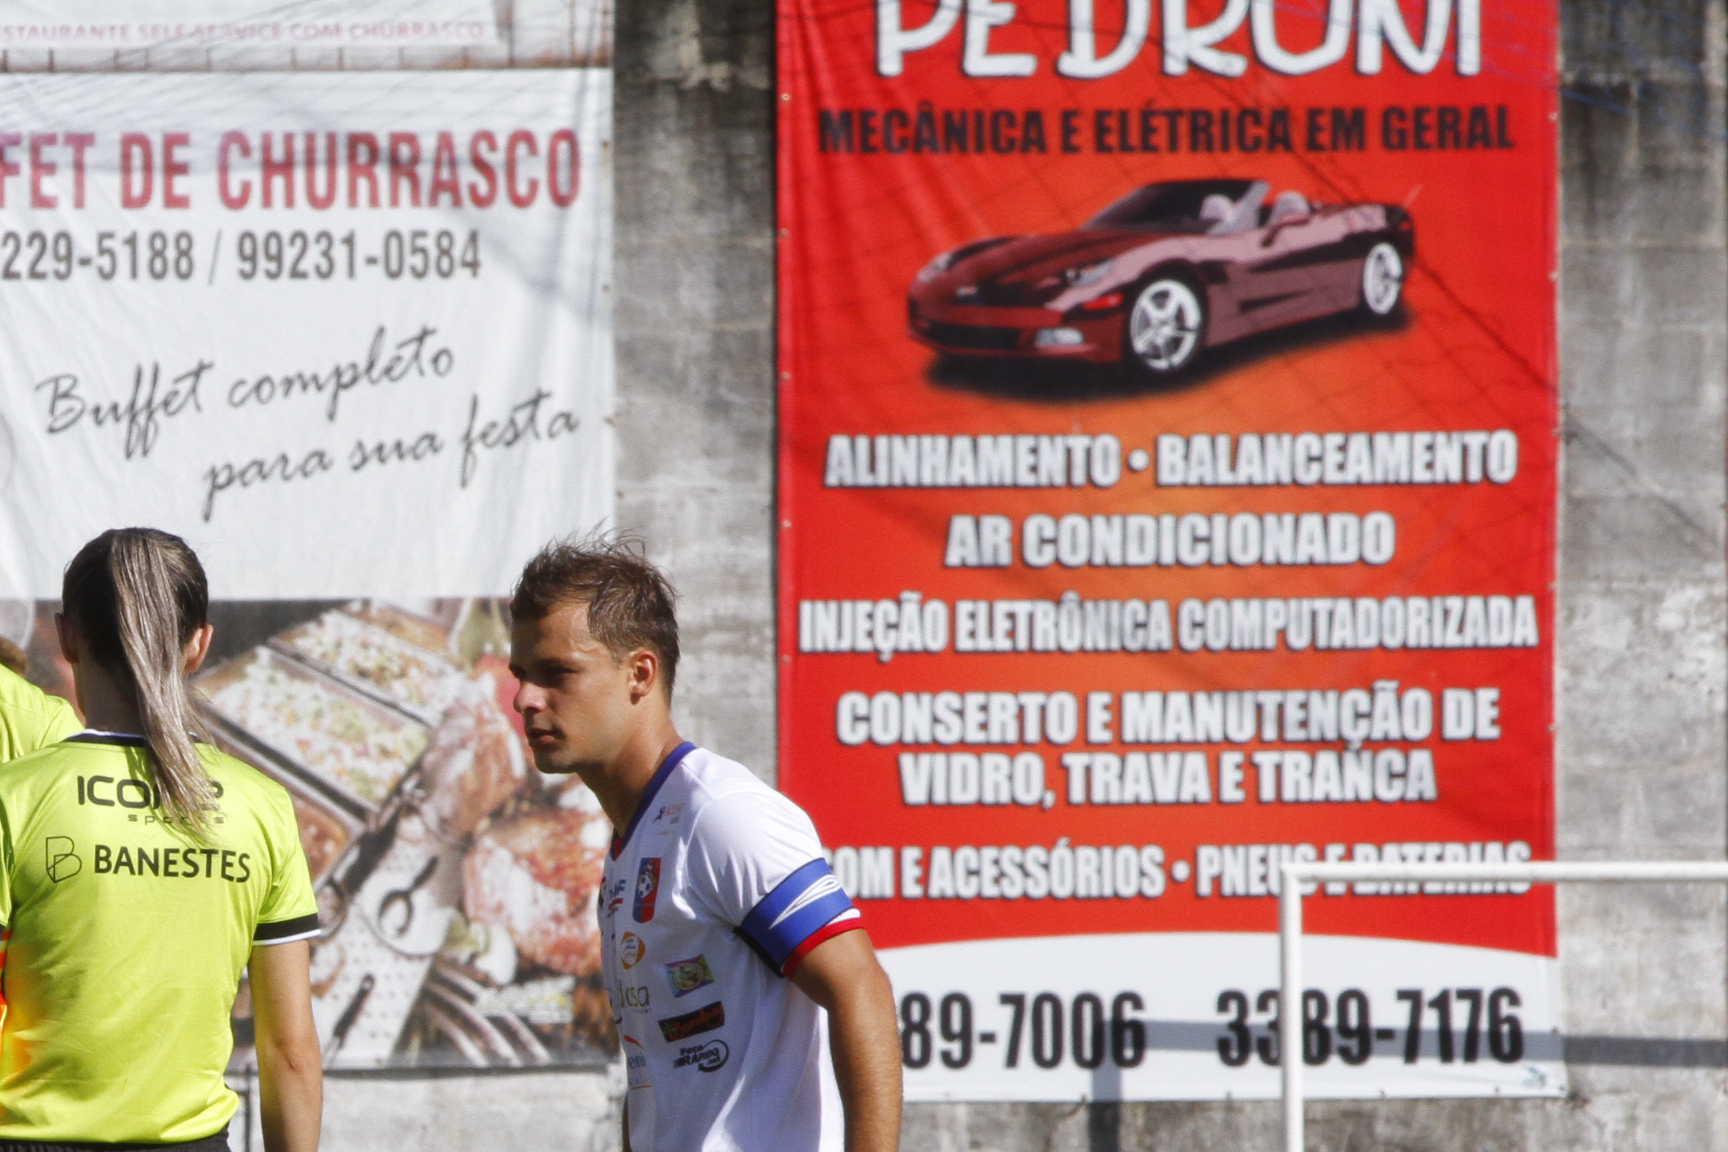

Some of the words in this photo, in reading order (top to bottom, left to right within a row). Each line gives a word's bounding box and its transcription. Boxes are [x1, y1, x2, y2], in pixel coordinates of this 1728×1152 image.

[290, 22, 342, 40] COM
[349, 21, 484, 40] CHURRASCO
[817, 101, 1048, 156] MECÂNICA
[1060, 109, 1082, 155] E
[1094, 99, 1290, 154] ELÉTRICA
[1306, 107, 1366, 153] EM
[1381, 104, 1517, 152] GERAL
[121, 132, 191, 210] DE
[218, 129, 582, 210] CHURRASCO
[237, 230, 482, 281] 99231-0584
[36, 360, 214, 459] Buffet
[227, 326, 454, 421] completo
[202, 449, 334, 523] para
[350, 431, 444, 473] sua
[460, 388, 580, 488] festa
[824, 433, 1122, 488] ALINHAMENTO
[1155, 430, 1519, 487] BALANCEAMENTO
[944, 514, 1012, 568] AR
[1023, 511, 1396, 568] CONDICIONADO
[798, 591, 949, 661] INJEÇÃO
[954, 591, 1173, 653] ELETRÔNICA
[1177, 595, 1539, 651] COMPUTADORIZADA
[835, 690, 1079, 746] CONSERTO
[1085, 691, 1113, 745] E
[1120, 680, 1434, 754] MANUTENÇÃO
[1443, 687, 1501, 741] DE
[899, 752, 1056, 809] VIDRO,
[1063, 751, 1212, 805] TRAVA
[1219, 750, 1246, 803] E
[1253, 748, 1438, 803] TRANCA
[94, 844, 251, 883] BANESTES
[901, 848, 923, 900] E
[928, 837, 1167, 900] ACESSÓRIOS
[1196, 843, 1319, 897] PNEUS
[1324, 844, 1348, 896] E
[1352, 840, 1532, 897] BATERIAS
[899, 992, 1147, 1070] 89-7006
[1216, 987, 1526, 1068] 3389-7176
